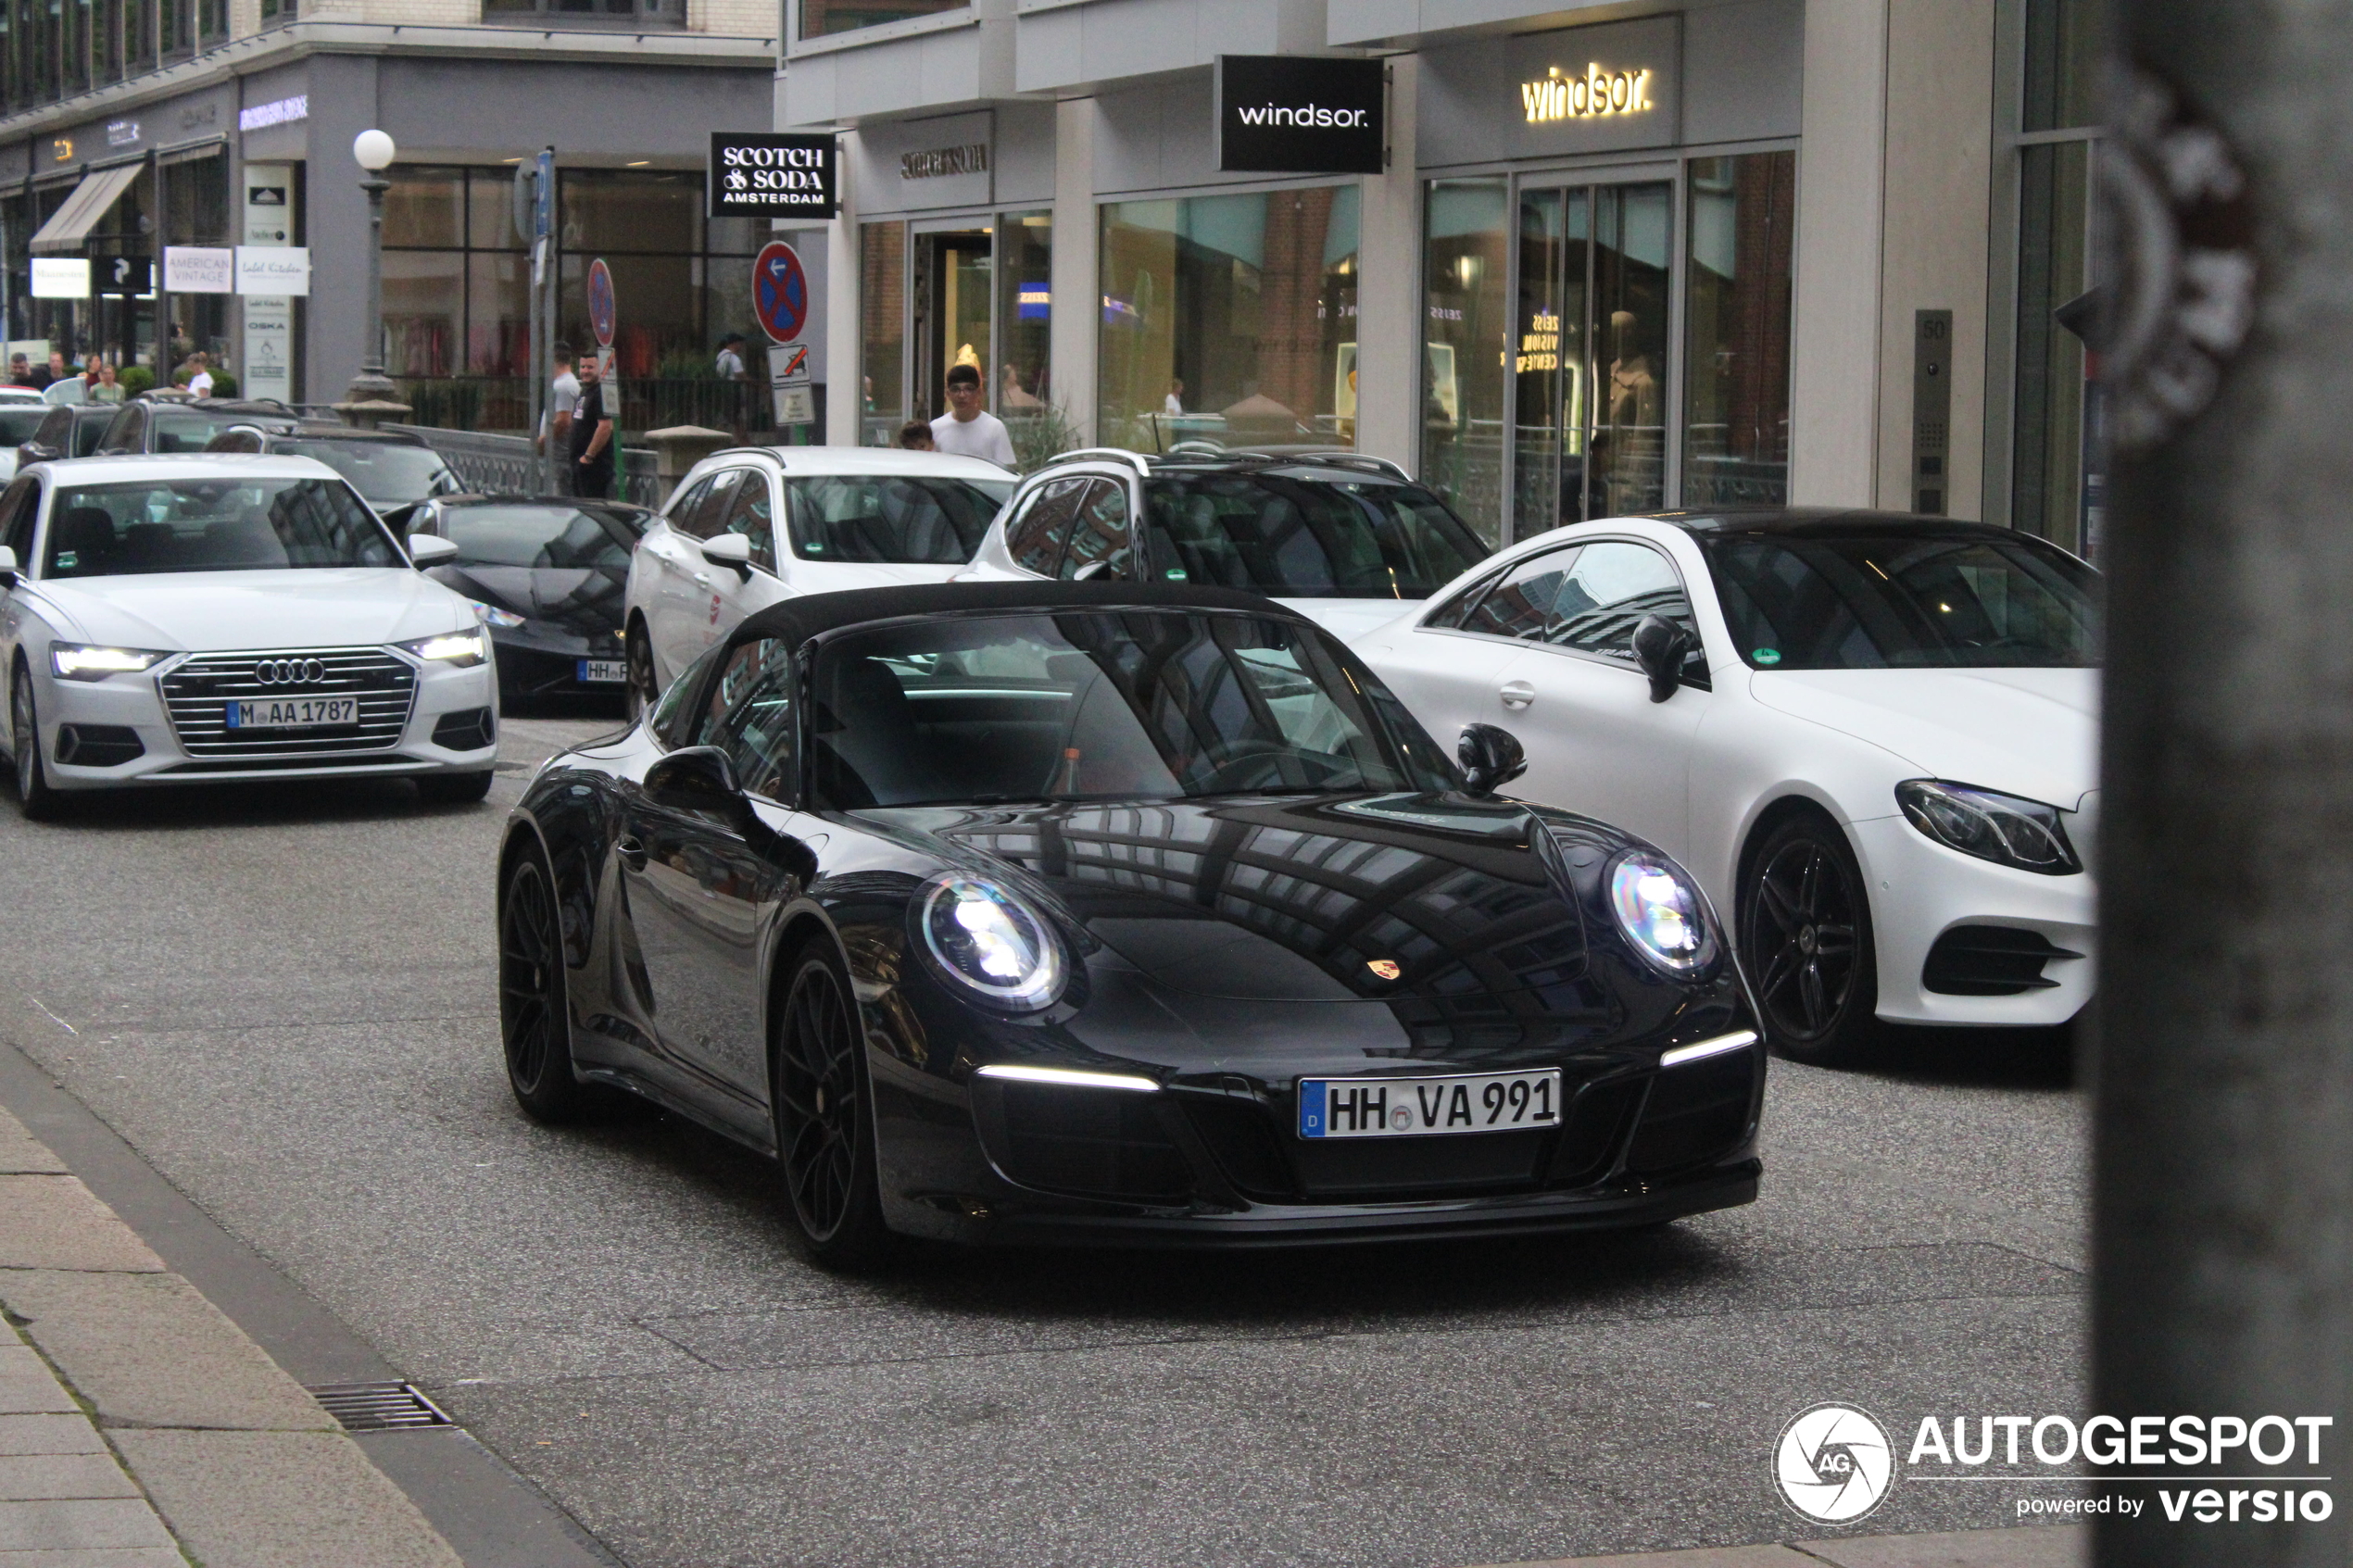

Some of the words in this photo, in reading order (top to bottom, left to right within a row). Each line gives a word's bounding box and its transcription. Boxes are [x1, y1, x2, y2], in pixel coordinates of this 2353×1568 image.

[1522, 62, 1652, 121] windsor.
[1238, 102, 1369, 128] windsor.
[724, 146, 824, 168] SCOTCH
[724, 168, 749, 190] &
[753, 169, 824, 190] SODA
[724, 193, 824, 204] AMSTERDAM
[169, 257, 229, 270] AMERICAN
[243, 262, 265, 273] Label
[269, 261, 302, 274] Kitchen
[174, 270, 223, 282] VINTAGE
[1922, 320, 1945, 340] 50
[588, 663, 610, 678] HH
[240, 703, 255, 724] M
[270, 702, 296, 723] AA
[301, 700, 354, 722] 1787
[1307, 1114, 1317, 1128] D
[1329, 1086, 1387, 1131] HH
[1417, 1084, 1472, 1127] VA
[1482, 1077, 1556, 1124] 991
